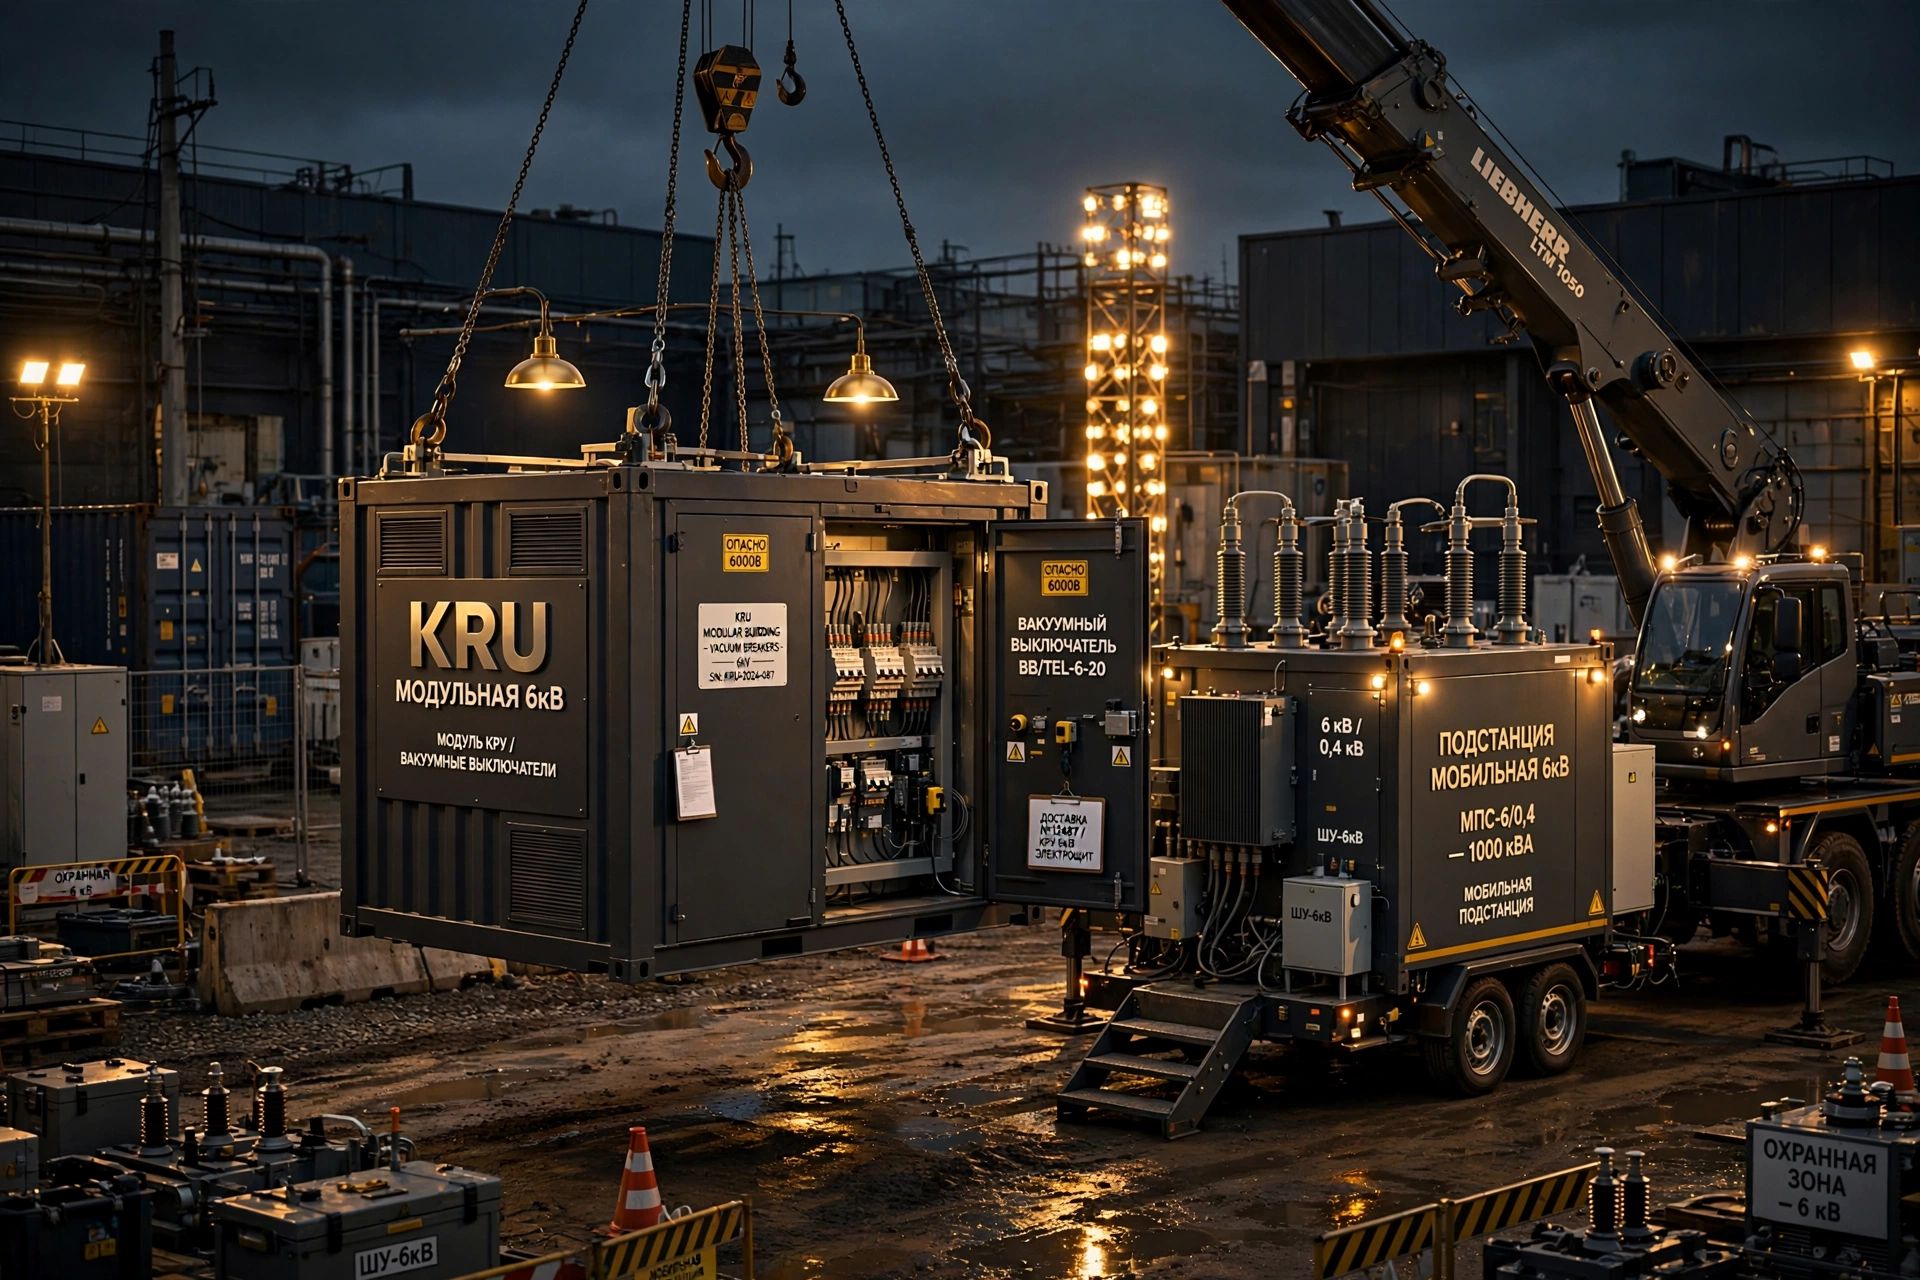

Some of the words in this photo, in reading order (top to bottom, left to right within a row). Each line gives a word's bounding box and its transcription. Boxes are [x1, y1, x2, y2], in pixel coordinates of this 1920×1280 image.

[1470, 146, 1570, 264] LIEBHERR
[1529, 235, 1556, 269] LTM
[1556, 263, 1585, 299] 1050
[726, 538, 766, 551] ОПАСНО
[730, 555, 762, 567] 6000В
[1048, 579, 1080, 591] 6000В
[735, 612, 752, 623] KRU
[1018, 614, 1107, 632] ВАКУУМНЫЙ
[410, 601, 548, 673] KRU
[1011, 638, 1117, 653] ВЫКЛЮЧАТЕЛЬ
[1018, 659, 1107, 677] ВВ/TEL-6-20
[396, 679, 520, 709] МОДУЛЬНАЯ
[525, 684, 564, 711] 6кВ
[1321, 717, 1331, 733] 6
[1333, 718, 1353, 734] кВ
[437, 732, 484, 750] МОДУЛЬ
[485, 736, 507, 752] КРУ
[1319, 738, 1342, 758] 0,4
[1345, 740, 1364, 756] кВ
[1439, 724, 1555, 758] ПОДСТАНЦИЯ
[400, 751, 466, 771] ВАКУУМНЫЕ
[469, 757, 557, 778] ВЫКЛЮЧАТЕЛИ
[1431, 757, 1539, 791] МОБИЛЬНАЯ
[1542, 754, 1570, 779] 6кВ
[1040, 813, 1087, 825] ДОСТАВКА
[1460, 803, 1536, 833] МПС-6/0,4
[1039, 837, 1055, 846] КРУ
[1317, 828, 1364, 845] ШУ-6кВ
[1468, 837, 1503, 862] 1000
[1505, 833, 1534, 857] кВА
[1464, 876, 1533, 902] МОБИЛЬНАЯ
[1291, 907, 1332, 923] ШУ-6кВ
[1459, 896, 1534, 925] ПОДСТАНЦИЯ
[1764, 1139, 1876, 1175] ОХРАННАЯ
[1788, 1169, 1846, 1197] ЗОНА
[1798, 1197, 1809, 1217] 6
[1816, 1201, 1841, 1222] кВ
[360, 1242, 433, 1276] ШУ-6кВ
